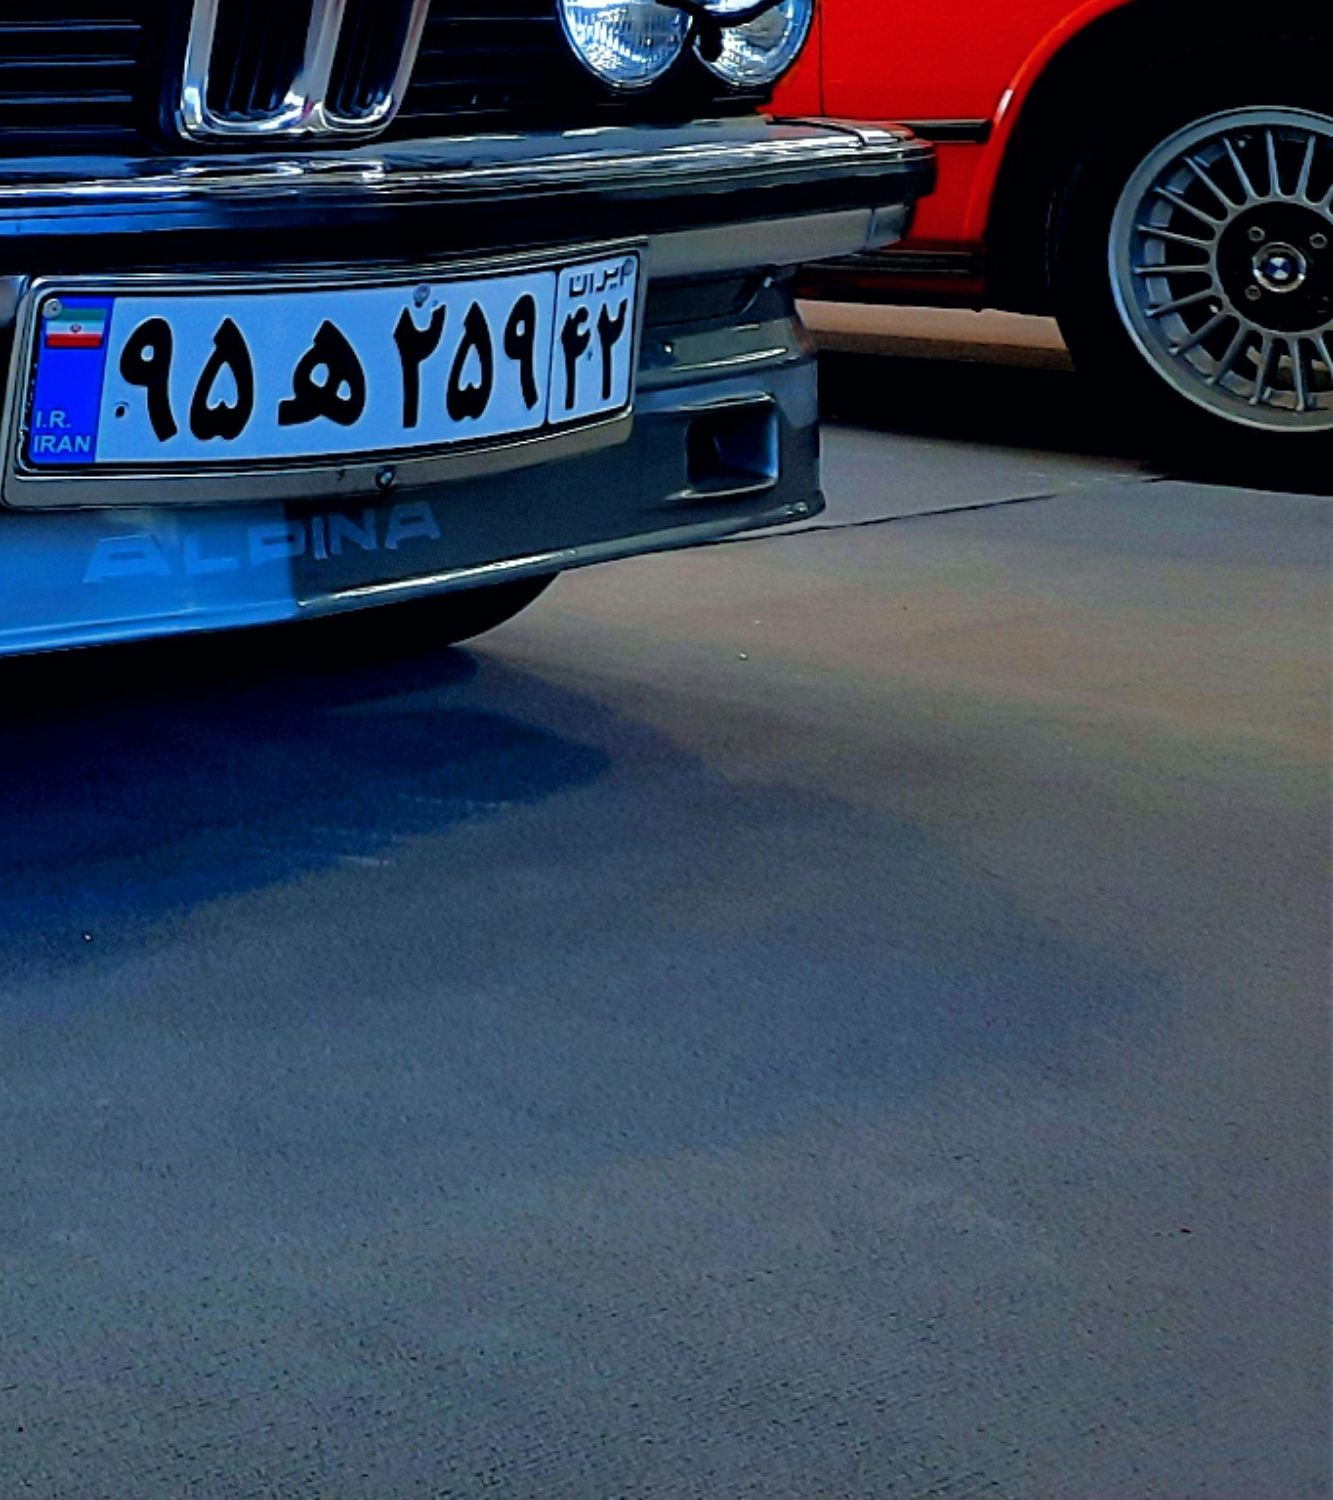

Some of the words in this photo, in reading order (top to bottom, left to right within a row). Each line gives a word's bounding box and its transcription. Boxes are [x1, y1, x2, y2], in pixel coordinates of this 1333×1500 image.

[36, 410, 72, 429] I.R.
[34, 434, 91, 454] IRAN
[82, 501, 441, 584] ALPINA
